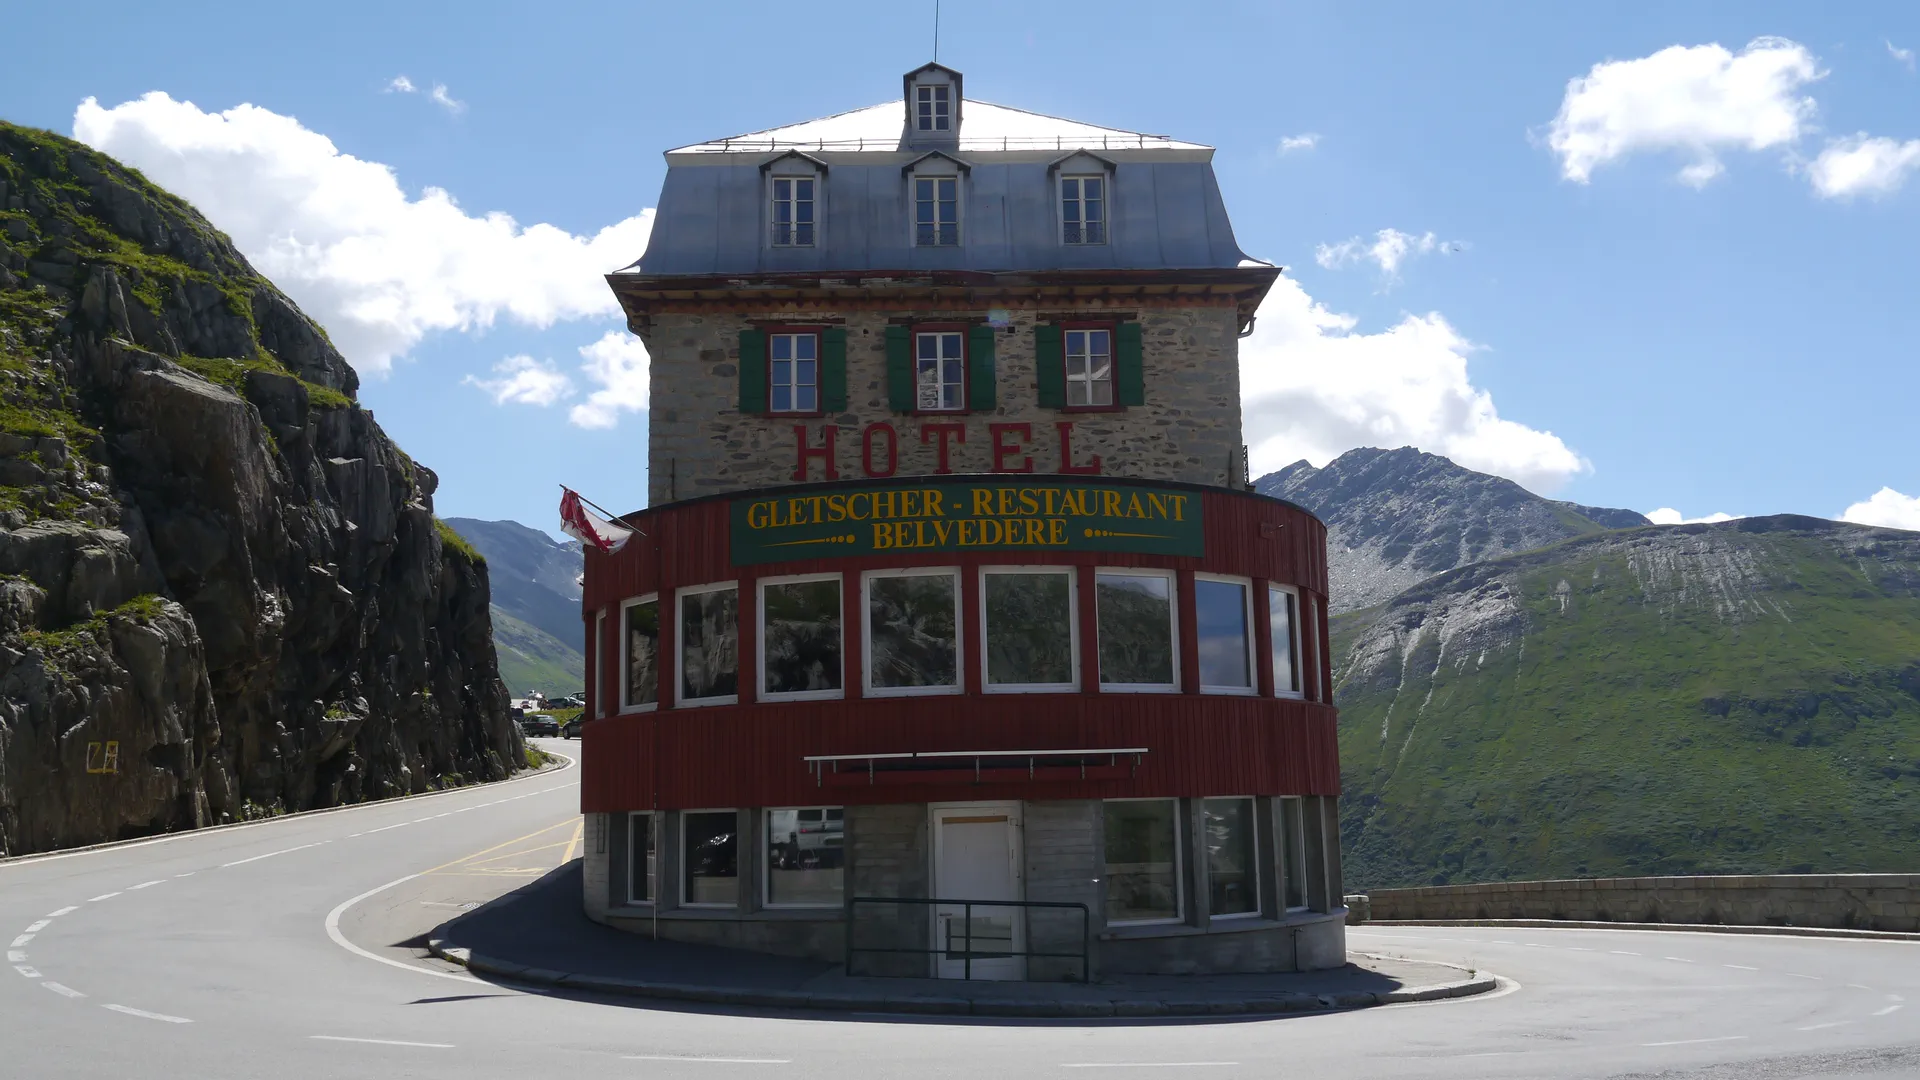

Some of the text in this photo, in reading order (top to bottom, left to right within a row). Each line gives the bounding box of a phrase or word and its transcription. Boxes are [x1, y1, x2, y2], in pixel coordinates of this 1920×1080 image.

[792, 421, 1101, 481] HOTEL
[746, 489, 945, 529] GLETSCHER
[972, 488, 1187, 521] RESTAURANT
[872, 518, 1069, 549] BELVEDERE
